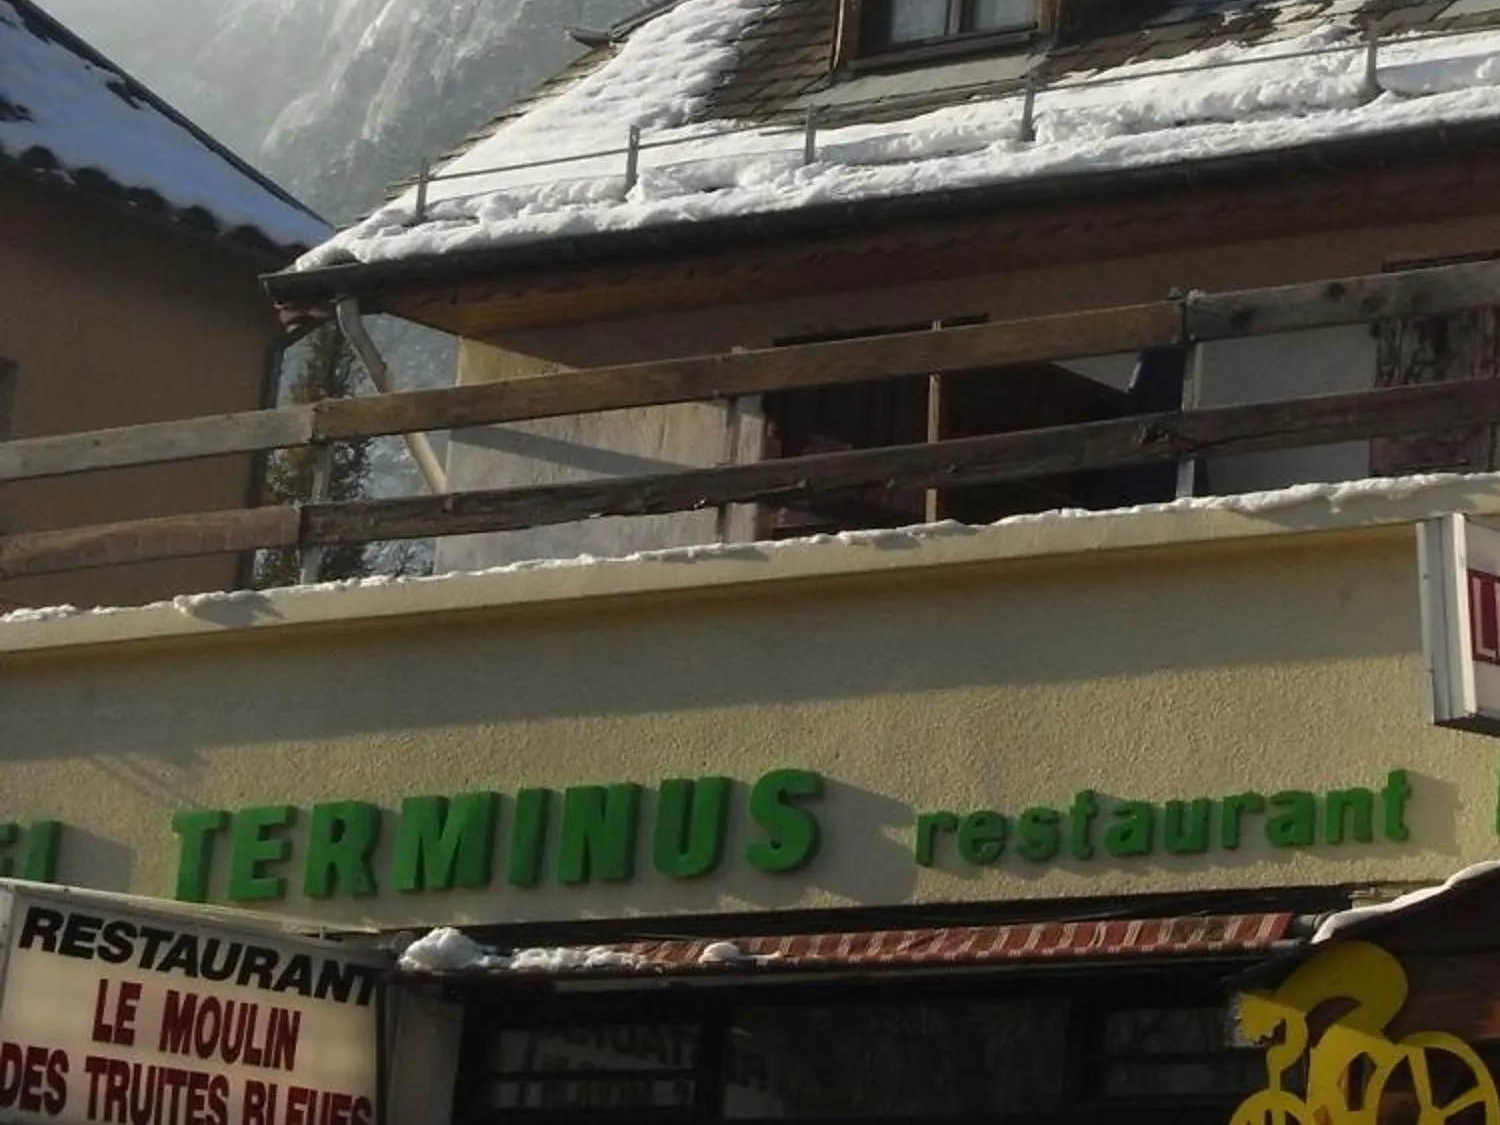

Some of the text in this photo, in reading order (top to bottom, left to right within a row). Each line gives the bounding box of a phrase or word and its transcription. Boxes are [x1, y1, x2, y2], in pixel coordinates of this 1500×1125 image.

[171, 767, 824, 902] TERMINUS
[914, 768, 1412, 868] restaurant
[18, 905, 382, 1007] RESTAURANT
[91, 978, 302, 1072] LE MOULIN
[0, 1041, 69, 1116] DES
[84, 1055, 230, 1125] TRUITES
